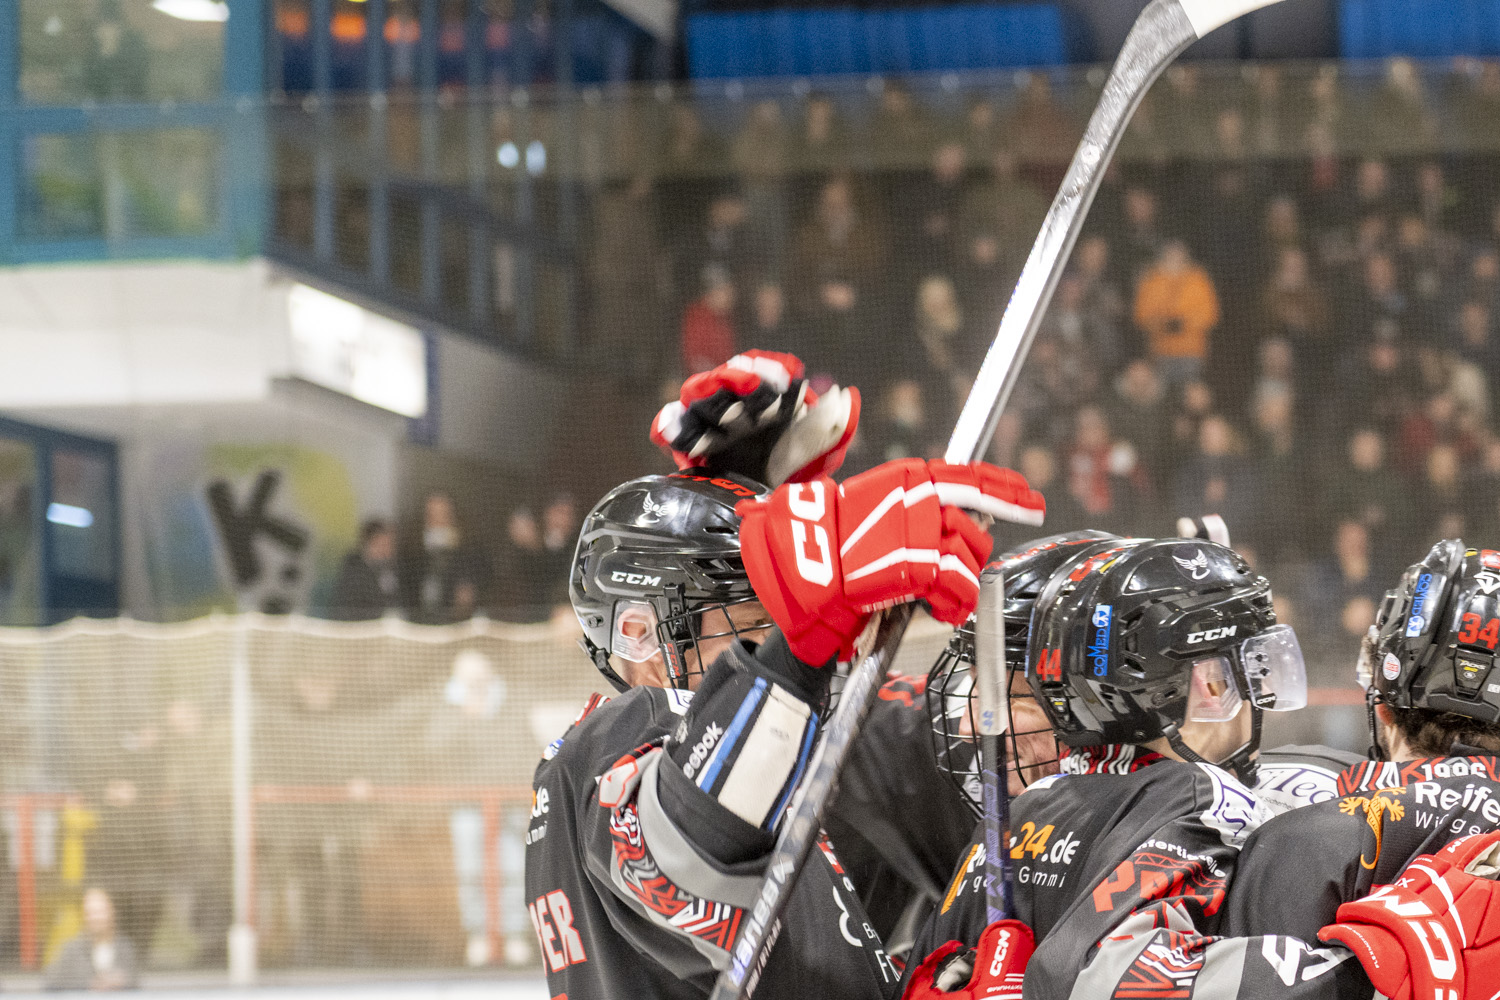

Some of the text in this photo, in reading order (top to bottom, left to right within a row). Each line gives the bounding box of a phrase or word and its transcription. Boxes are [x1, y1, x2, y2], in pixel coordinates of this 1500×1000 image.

[611, 570, 661, 587] CCM
[1186, 625, 1237, 644] CCM
[1457, 612, 1500, 650] 34
[1036, 648, 1062, 681] 44
[682, 721, 724, 779] eebok
[989, 929, 1011, 977] CCM
